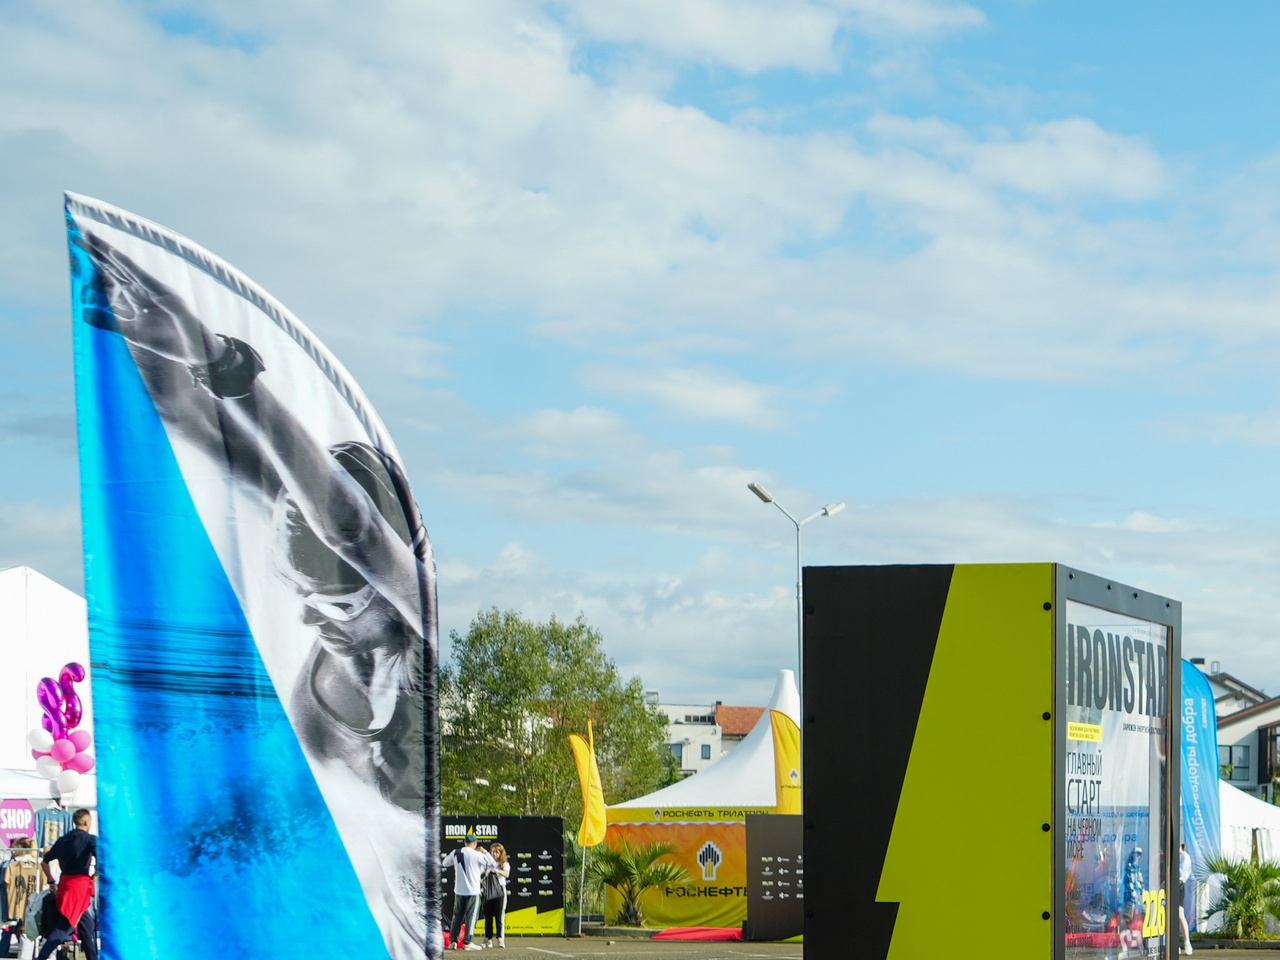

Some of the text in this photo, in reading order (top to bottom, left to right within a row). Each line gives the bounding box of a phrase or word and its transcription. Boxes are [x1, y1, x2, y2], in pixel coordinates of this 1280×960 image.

[1068, 623, 1167, 718] IRONSTAR
[1182, 698, 1198, 743] добра
[1067, 749, 1102, 776] ГЛАВНЫЙ
[1067, 778, 1102, 814] СТАРТ
[0, 808, 32, 829] SHOP
[445, 825, 498, 835] IRON STAR
[1142, 889, 1166, 938] 226
